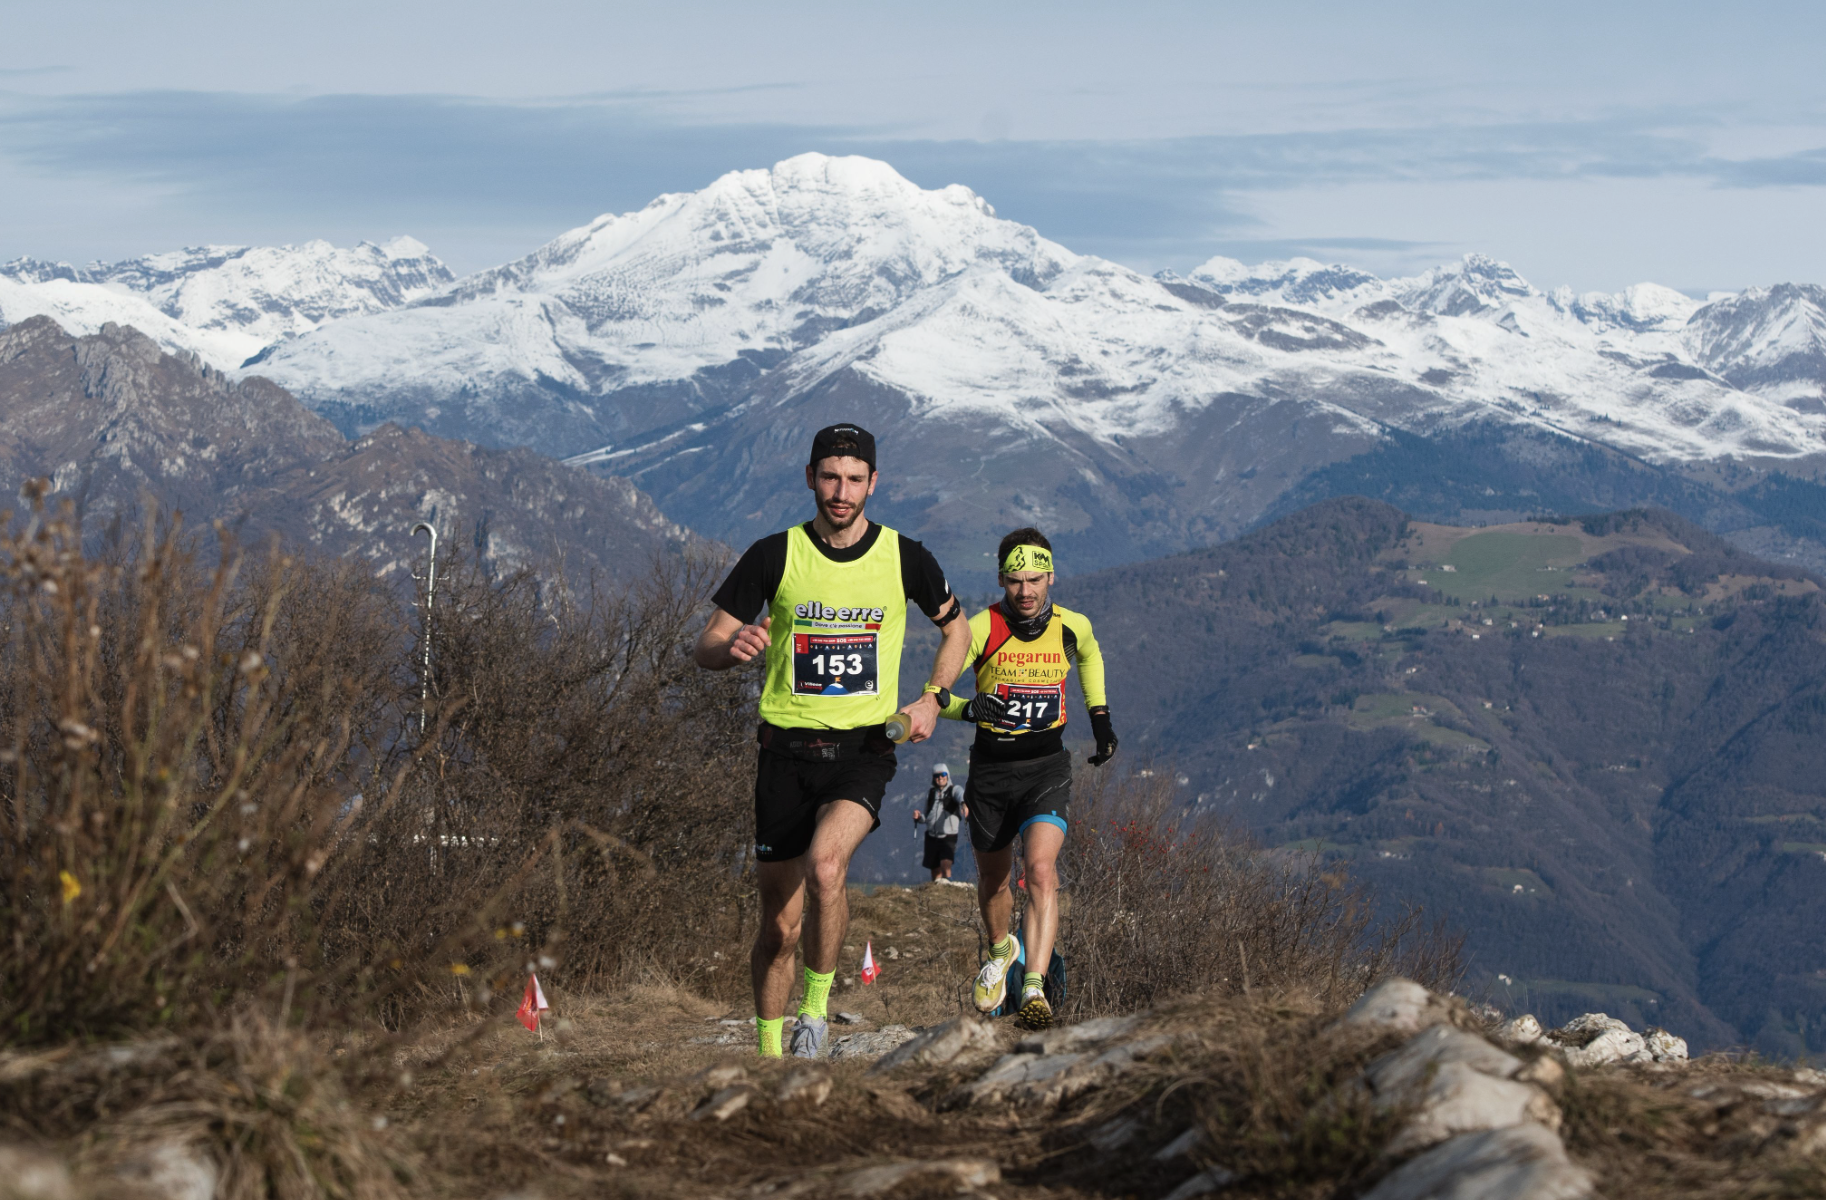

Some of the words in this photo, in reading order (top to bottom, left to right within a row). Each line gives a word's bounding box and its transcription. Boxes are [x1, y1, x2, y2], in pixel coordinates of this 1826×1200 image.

[812, 654, 863, 675] 153
[997, 651, 1061, 667] pegarun
[989, 666, 1017, 677] TEAM
[1028, 668, 1066, 678] BEAUTY
[1007, 700, 1048, 718] 217
